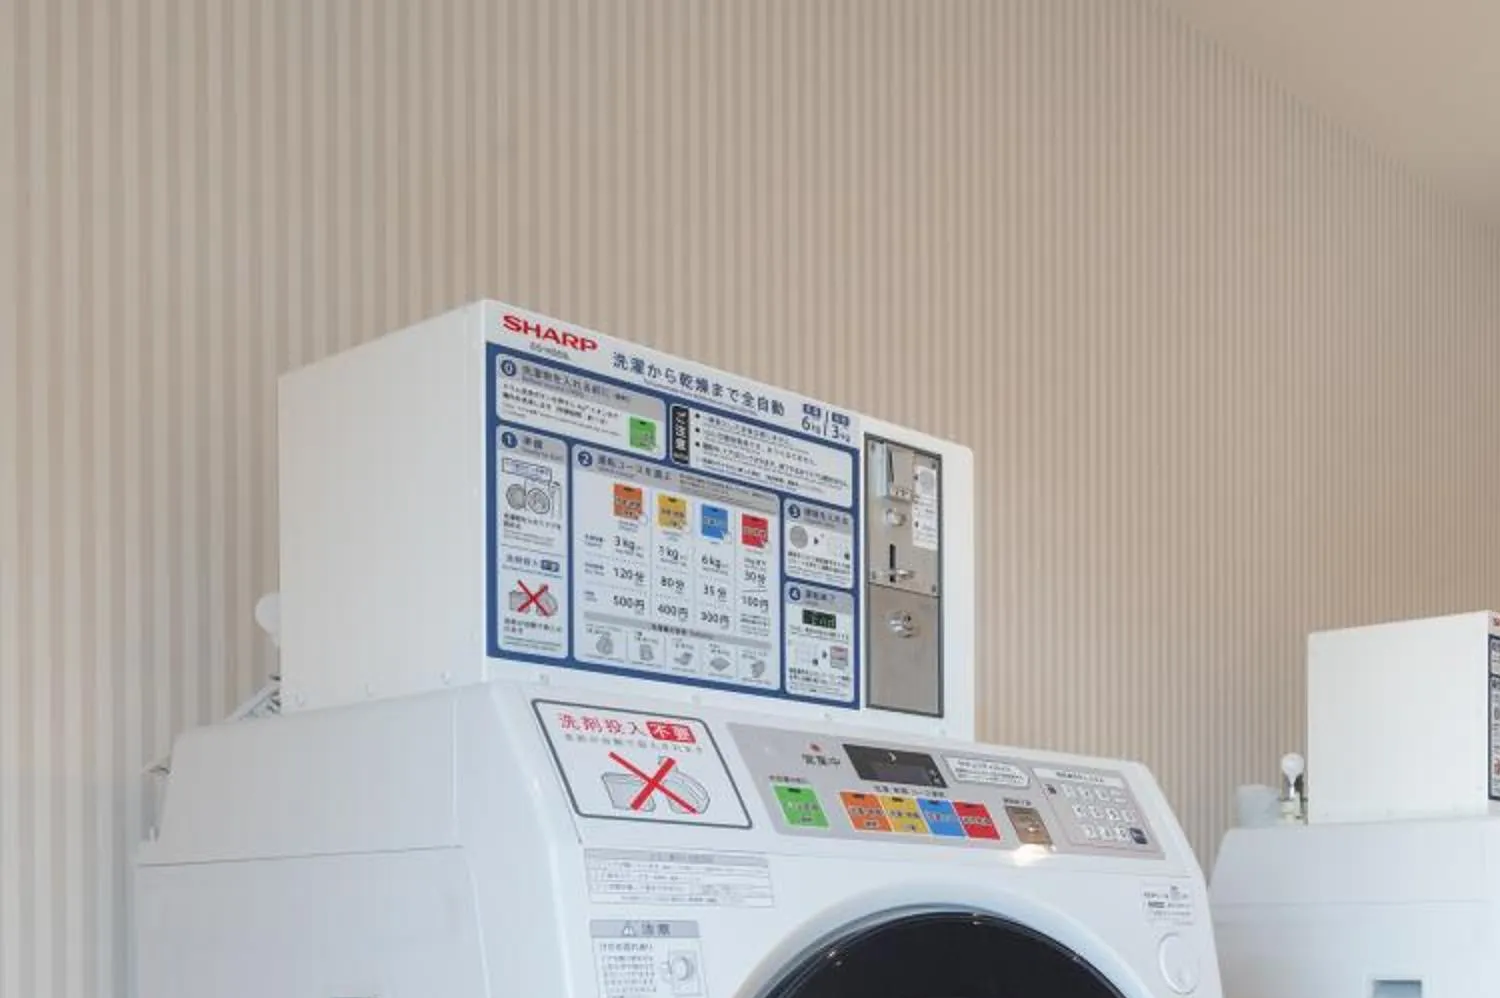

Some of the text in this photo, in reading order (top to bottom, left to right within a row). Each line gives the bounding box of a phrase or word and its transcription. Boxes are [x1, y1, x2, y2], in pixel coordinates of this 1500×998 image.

[503, 315, 598, 351] SHARP
[611, 351, 786, 417] 洗濯から乾燥まで全自動
[558, 713, 646, 736] 洗剤投入
